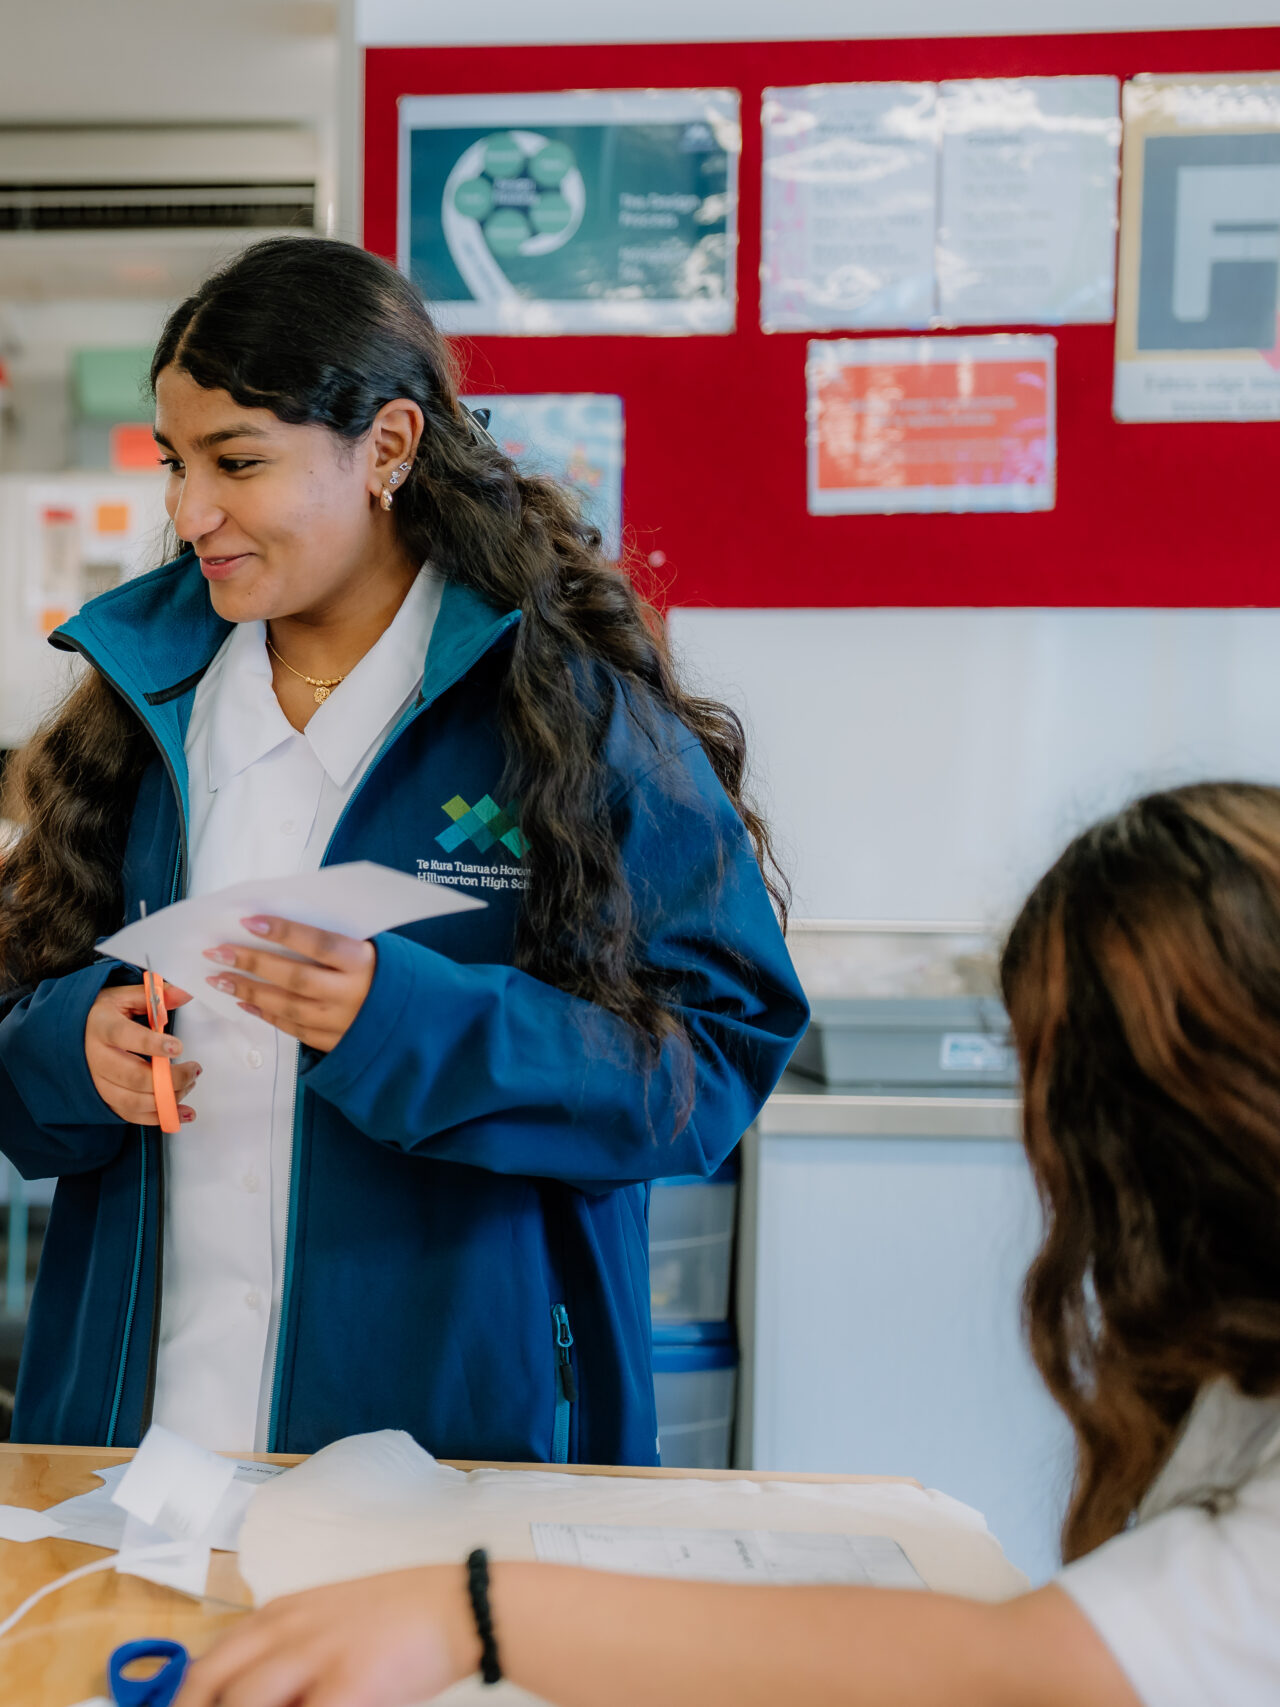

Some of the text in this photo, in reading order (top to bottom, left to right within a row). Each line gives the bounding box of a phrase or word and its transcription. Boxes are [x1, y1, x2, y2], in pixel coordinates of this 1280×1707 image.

[416, 859, 533, 877] Te Kura Tuarua o Horom
[417, 872, 531, 890] Hillmorton High Sch
